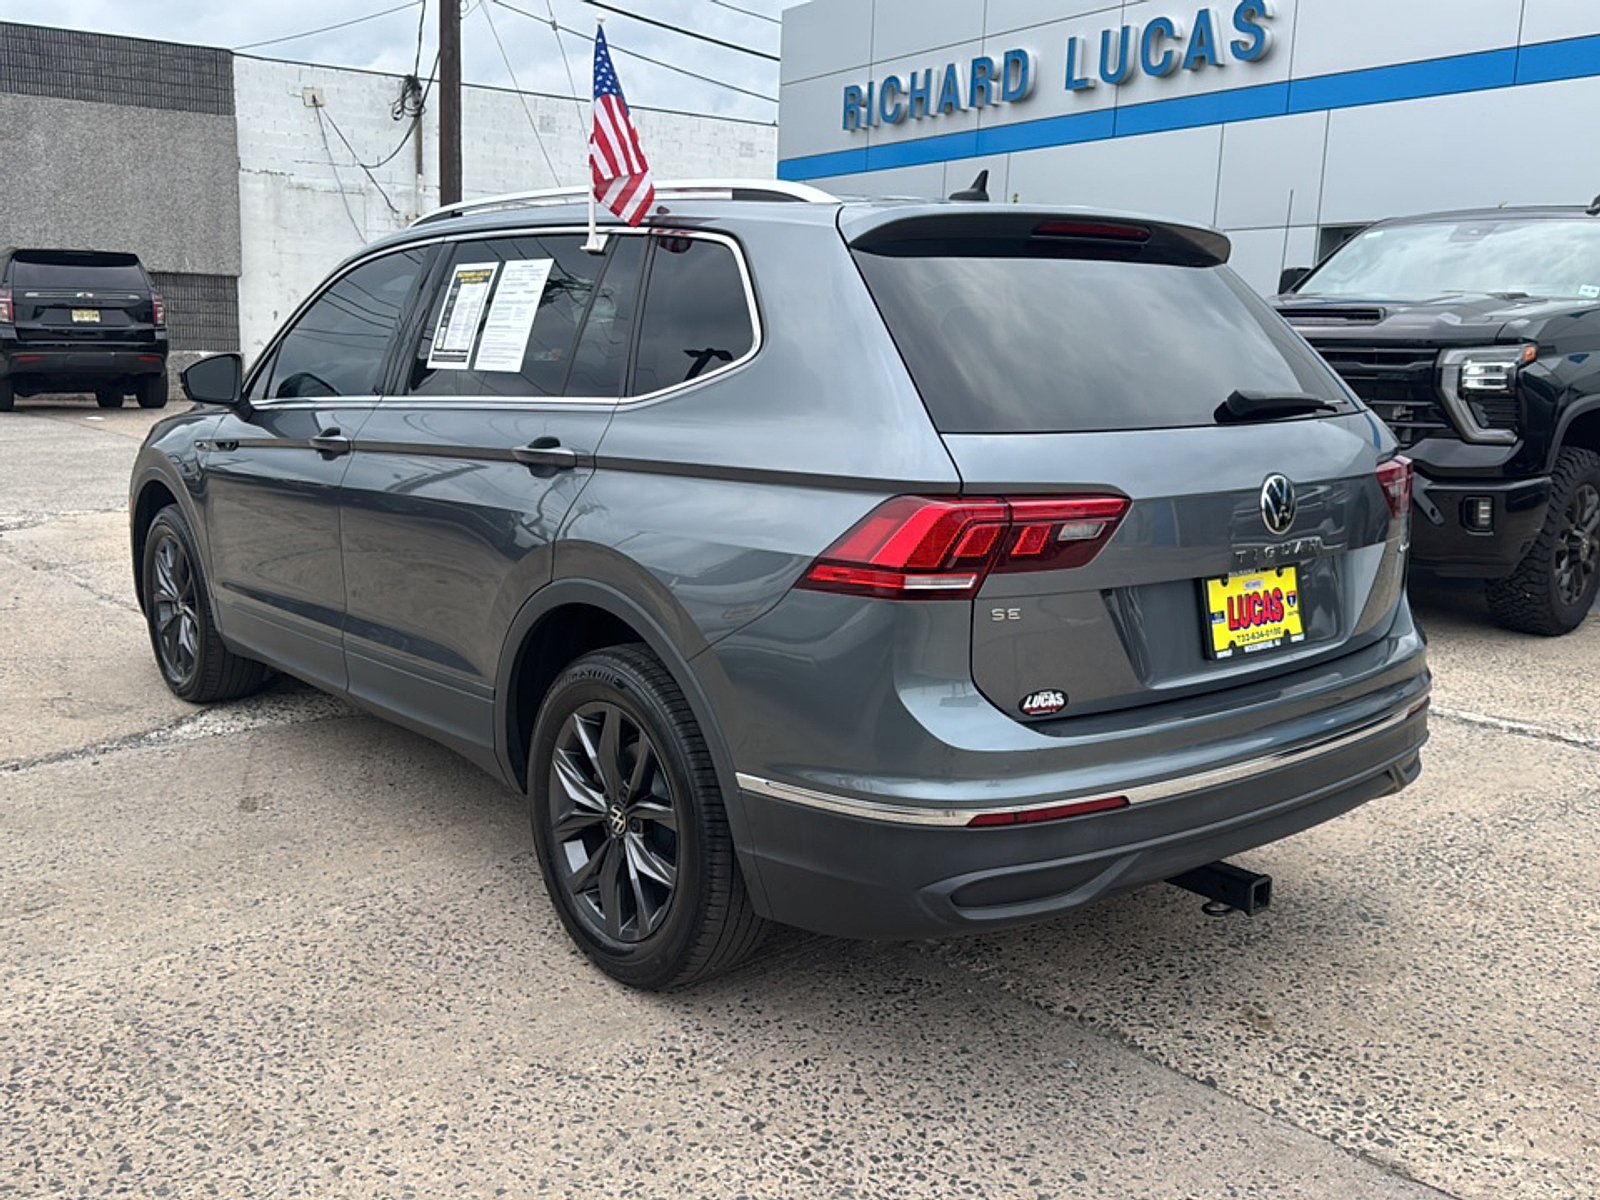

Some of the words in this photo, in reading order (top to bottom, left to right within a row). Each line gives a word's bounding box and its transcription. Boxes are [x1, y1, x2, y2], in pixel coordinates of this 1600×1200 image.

[842, 48, 1035, 131] RICHARD
[1064, 0, 1271, 91] LUCAS
[991, 608, 1021, 621] SE
[1226, 587, 1285, 631] LUCAS
[1022, 692, 1065, 709] LUCAS
